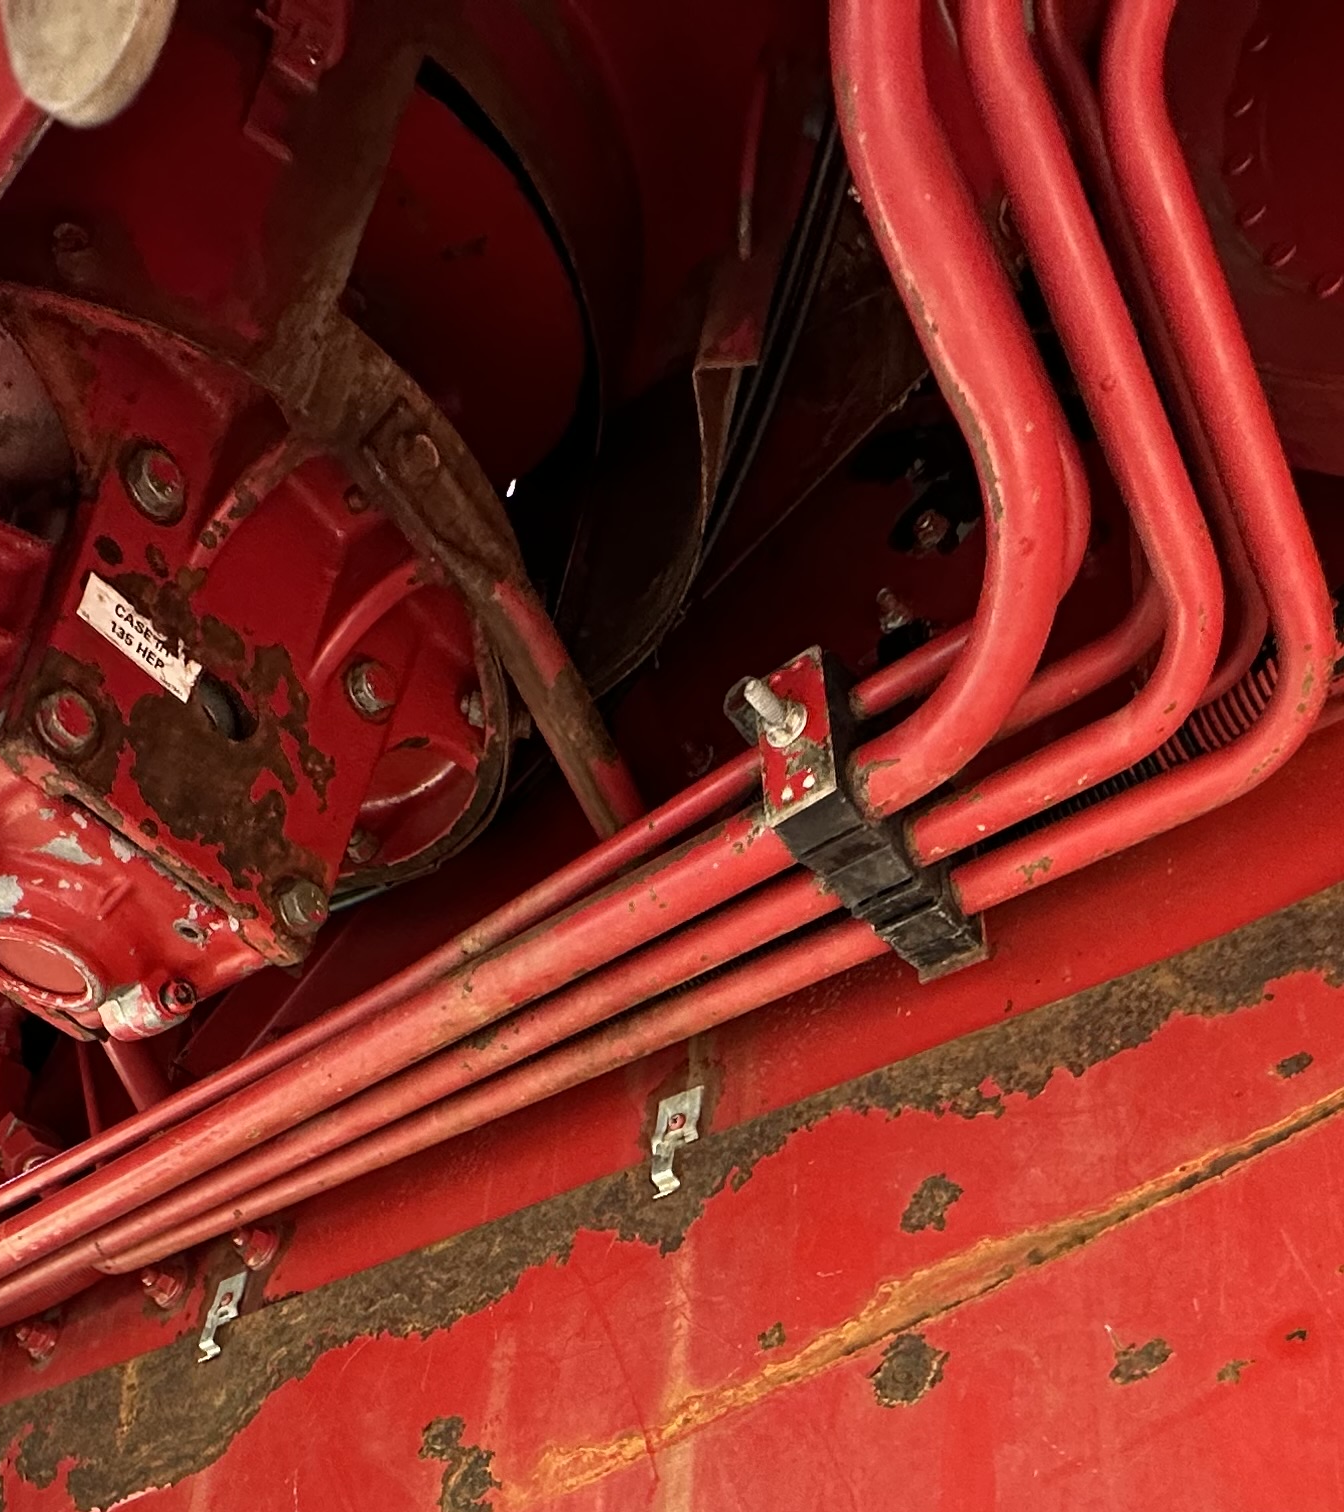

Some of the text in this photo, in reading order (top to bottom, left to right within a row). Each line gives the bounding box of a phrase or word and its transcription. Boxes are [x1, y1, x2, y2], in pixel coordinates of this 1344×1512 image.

[111, 620, 165, 670] 135 HEP
[115, 604, 153, 644] CASE
